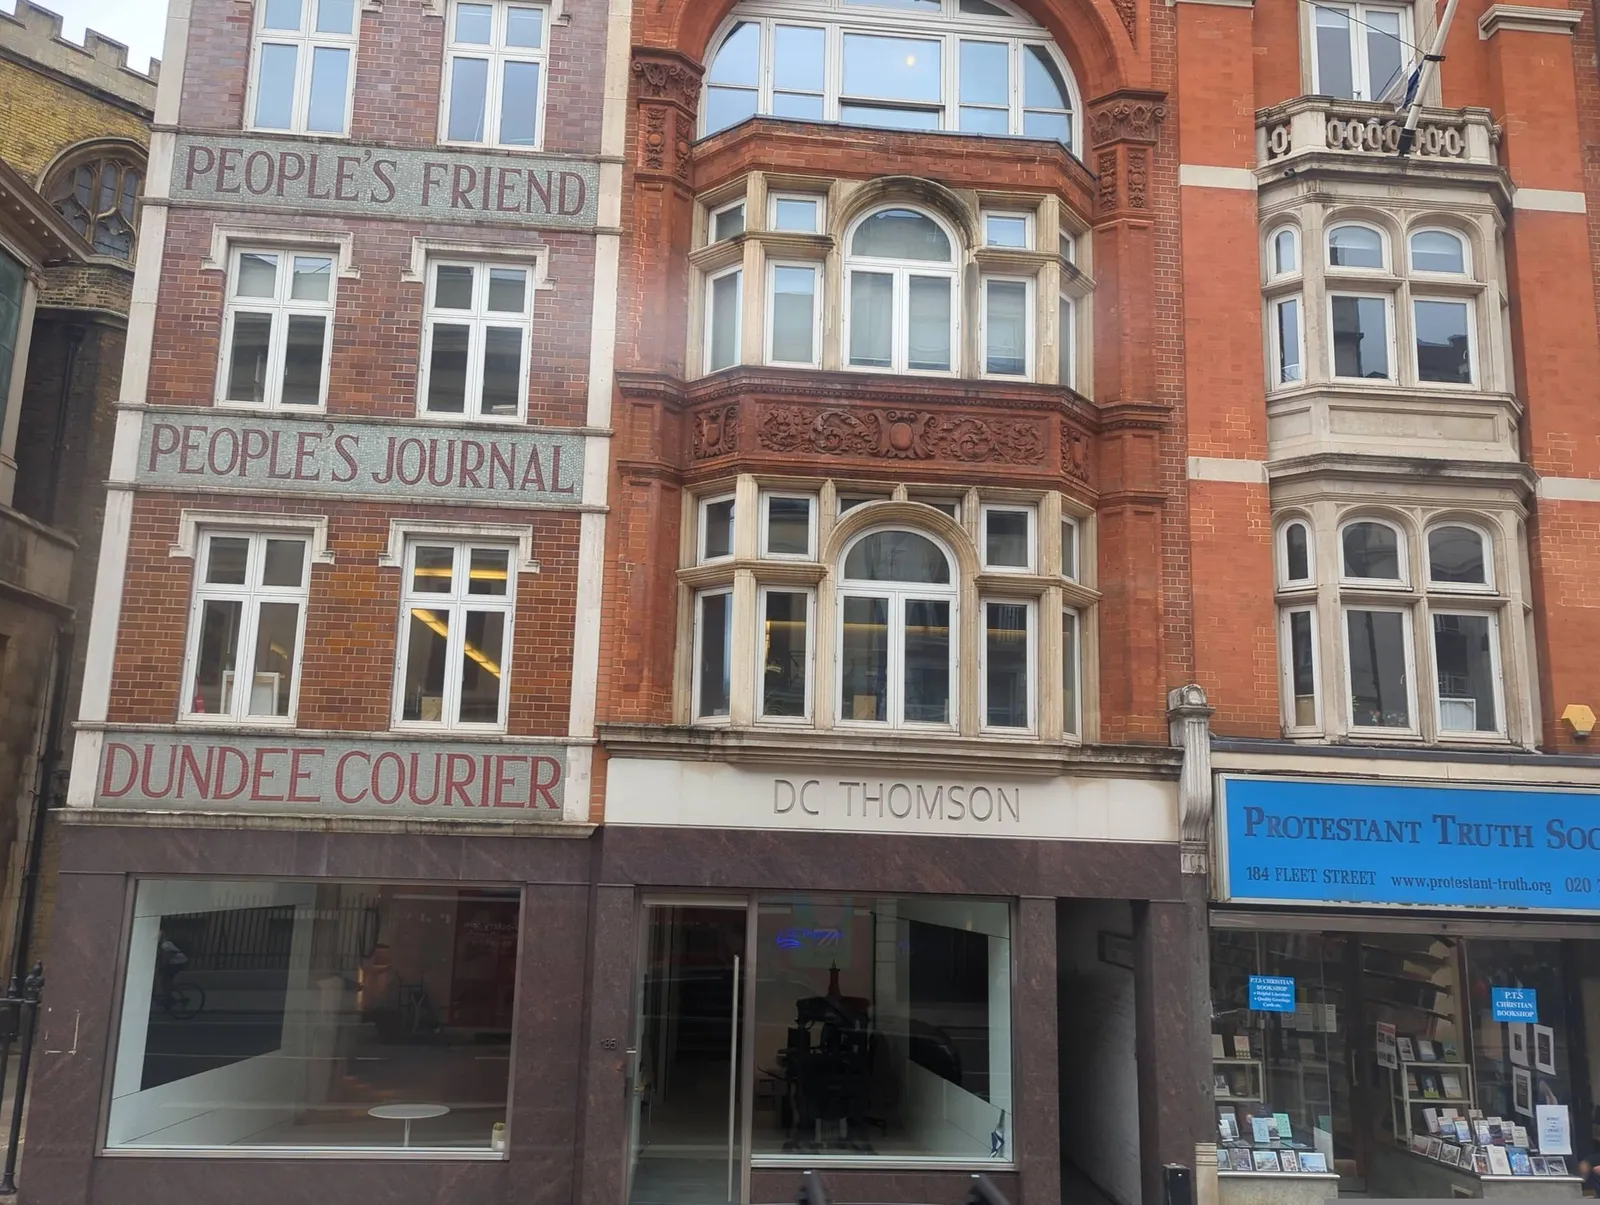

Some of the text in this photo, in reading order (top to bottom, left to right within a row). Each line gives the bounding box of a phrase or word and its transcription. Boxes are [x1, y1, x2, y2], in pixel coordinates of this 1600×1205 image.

[184, 145, 587, 217] PEOPLE'S FRIEND
[148, 423, 575, 494] PEOPLE'S JOURNAL
[100, 742, 563, 809] DUNDEE COURIER
[773, 779, 1020, 823] DC THOMSON
[1246, 866, 1270, 882] 184
[1275, 867, 1317, 884] FLEET
[1322, 868, 1377, 886] STREET
[1391, 874, 1552, 896] www.protestant-truth.org
[1565, 877, 1592, 893] 020
[1496, 1001, 1533, 1009] CHRISTIAN
[1496, 1010, 1534, 1018] BOOKSHOP
